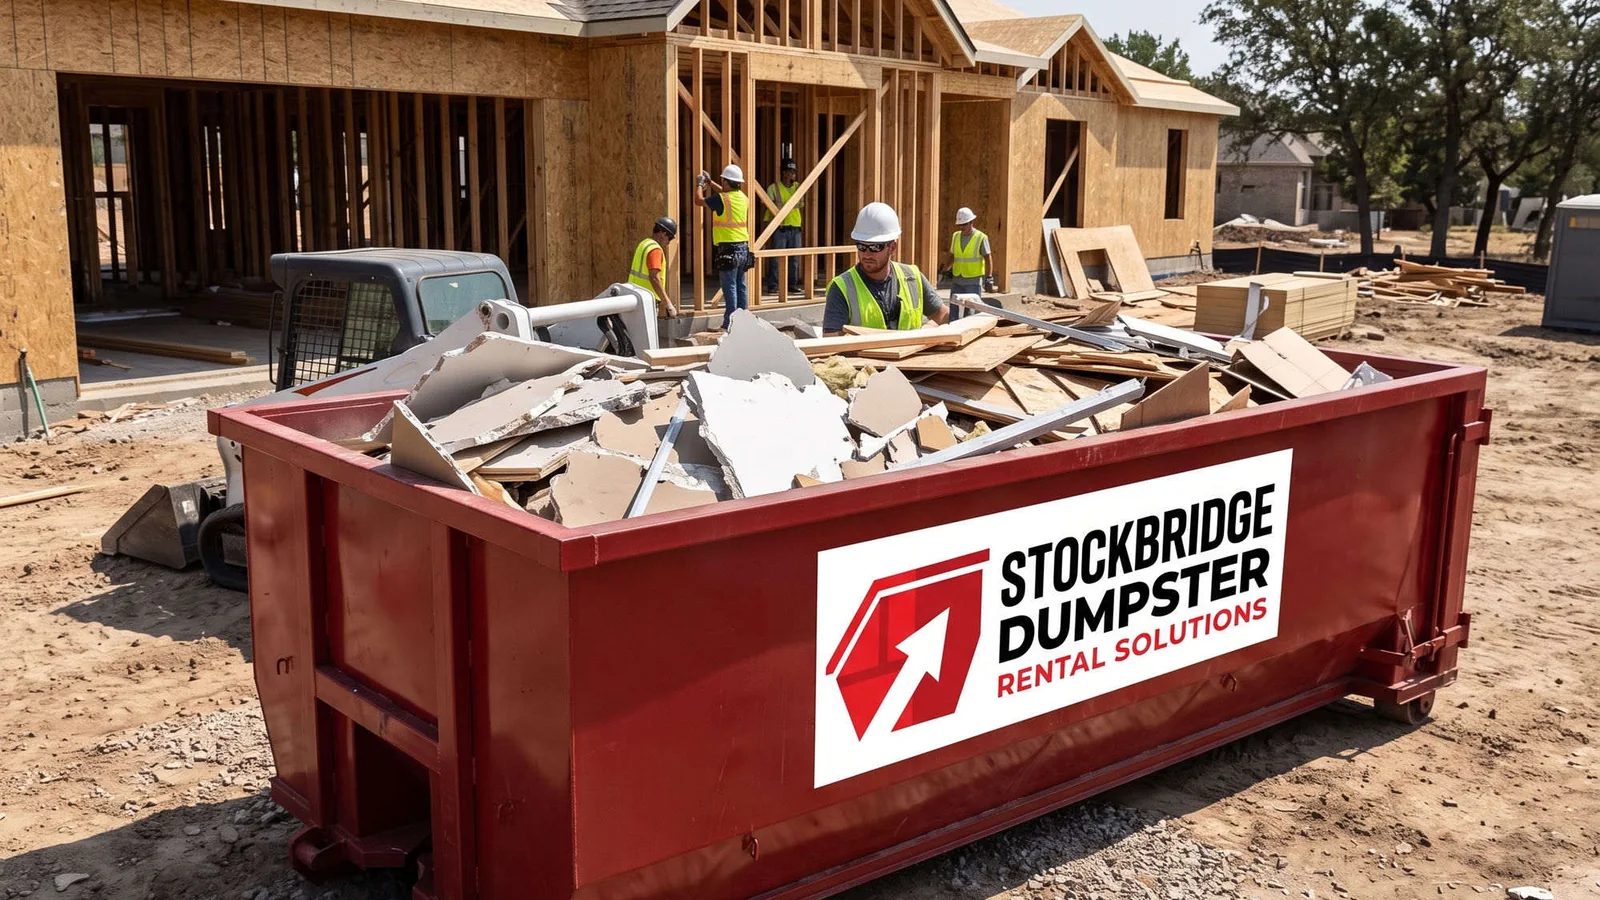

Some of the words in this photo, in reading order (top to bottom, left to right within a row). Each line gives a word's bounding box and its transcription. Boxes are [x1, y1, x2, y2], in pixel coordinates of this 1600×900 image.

[1001, 484, 1276, 608] STOCKBRIDGE
[997, 646, 1106, 698] RENTAL
[1114, 597, 1267, 662] SOLUTIONS
[998, 548, 1270, 664] DUMPSTER
